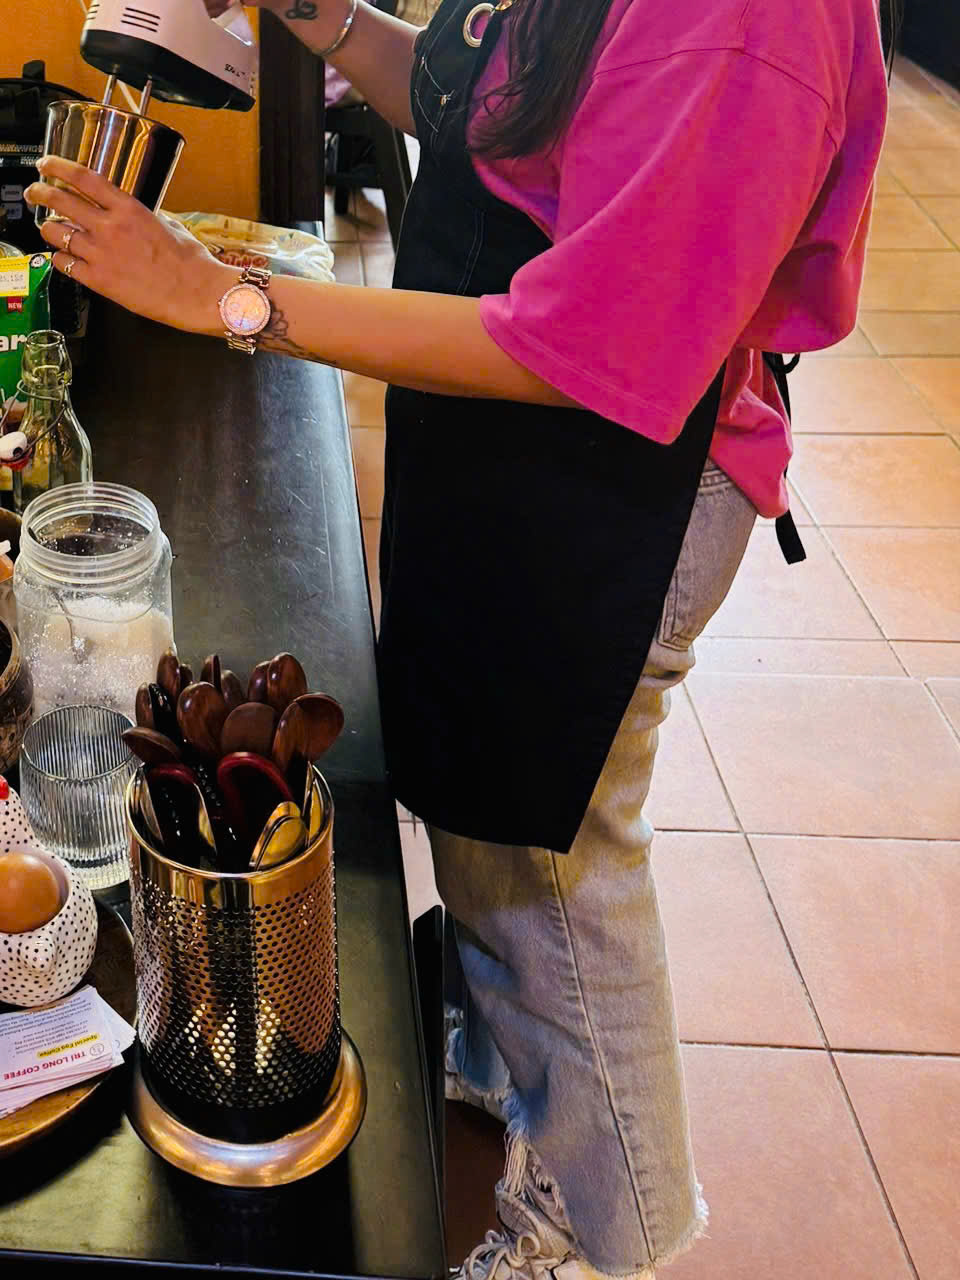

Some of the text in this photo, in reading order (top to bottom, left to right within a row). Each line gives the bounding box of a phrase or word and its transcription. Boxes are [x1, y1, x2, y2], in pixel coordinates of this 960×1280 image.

[8, 301, 22, 310] NEW
[74, 1034, 98, 1048] Special
[38, 1047, 60, 1057] Coffee
[43, 1056, 69, 1070] LONG
[3, 1065, 40, 1080] COFFEE
